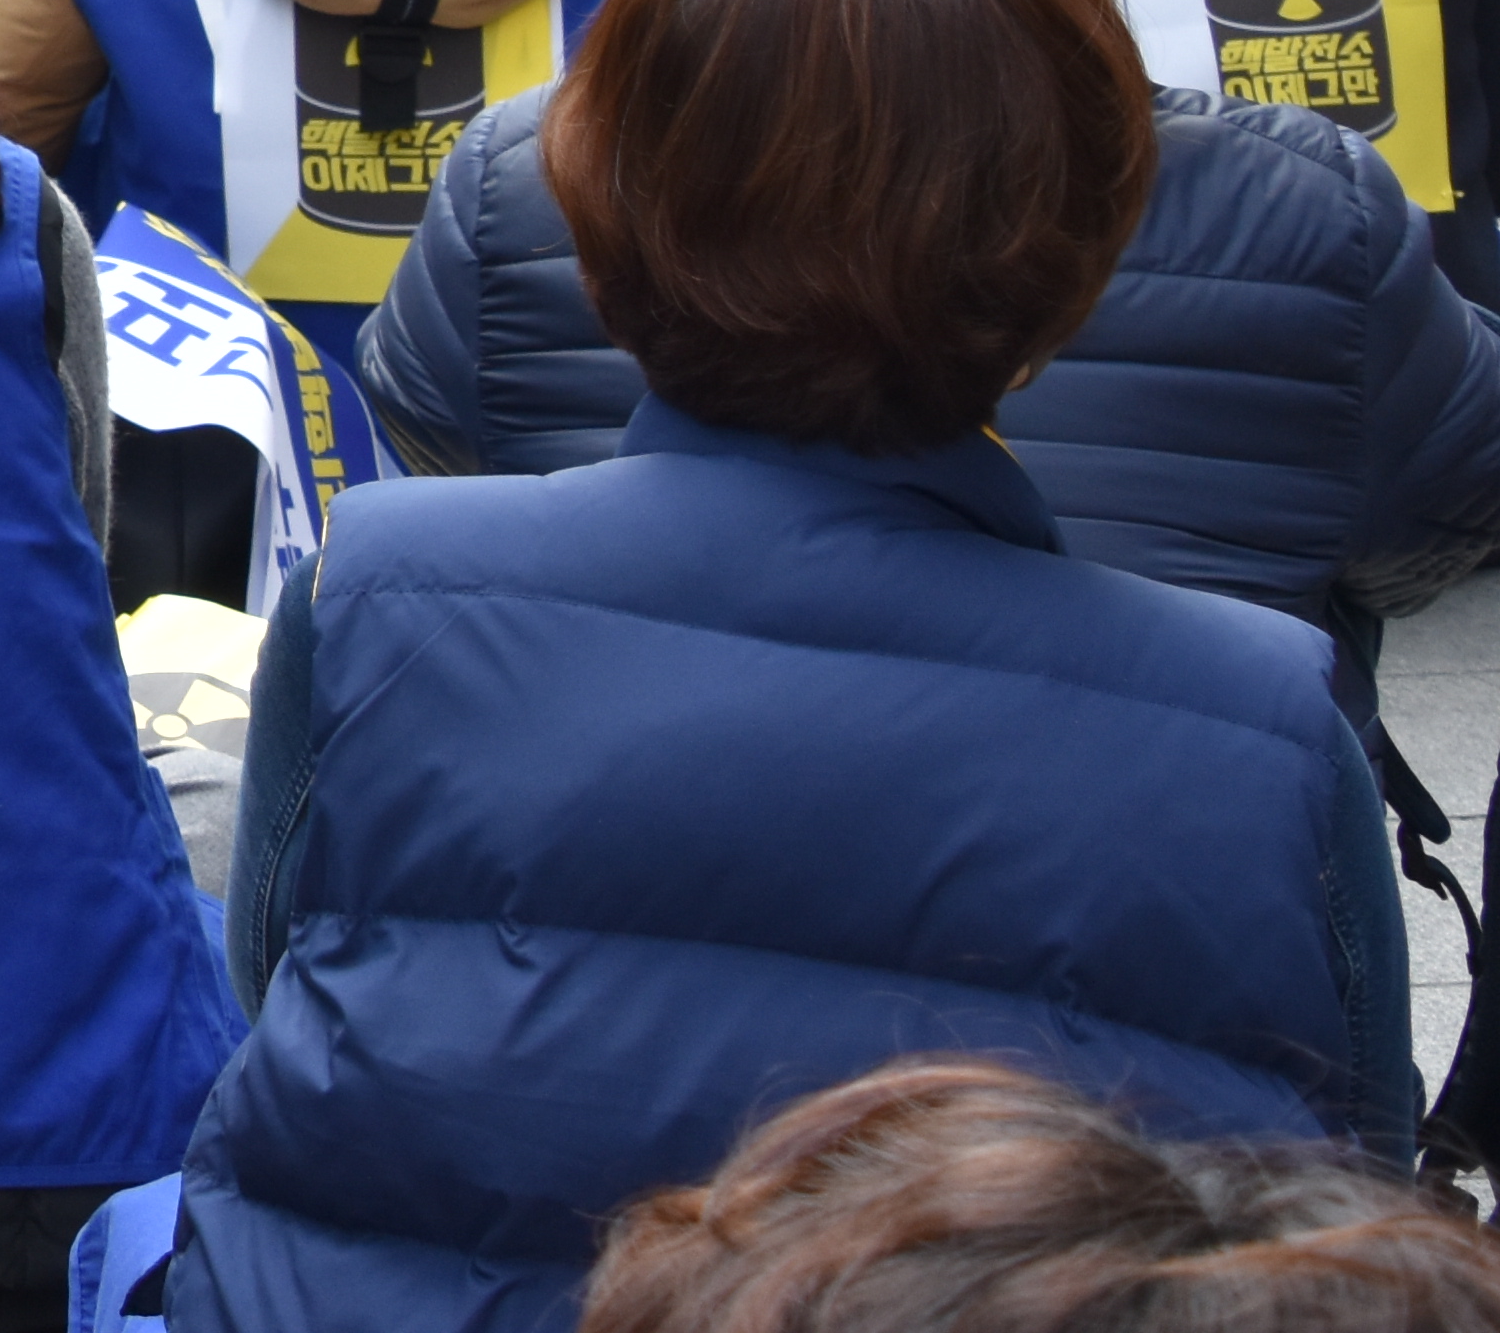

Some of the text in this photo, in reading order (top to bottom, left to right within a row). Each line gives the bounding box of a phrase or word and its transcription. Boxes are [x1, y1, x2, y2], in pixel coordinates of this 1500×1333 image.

[1220, 29, 1375, 75] 핵발전소
[1223, 67, 1382, 108] 이제그만
[301, 155, 441, 194] 이제그
